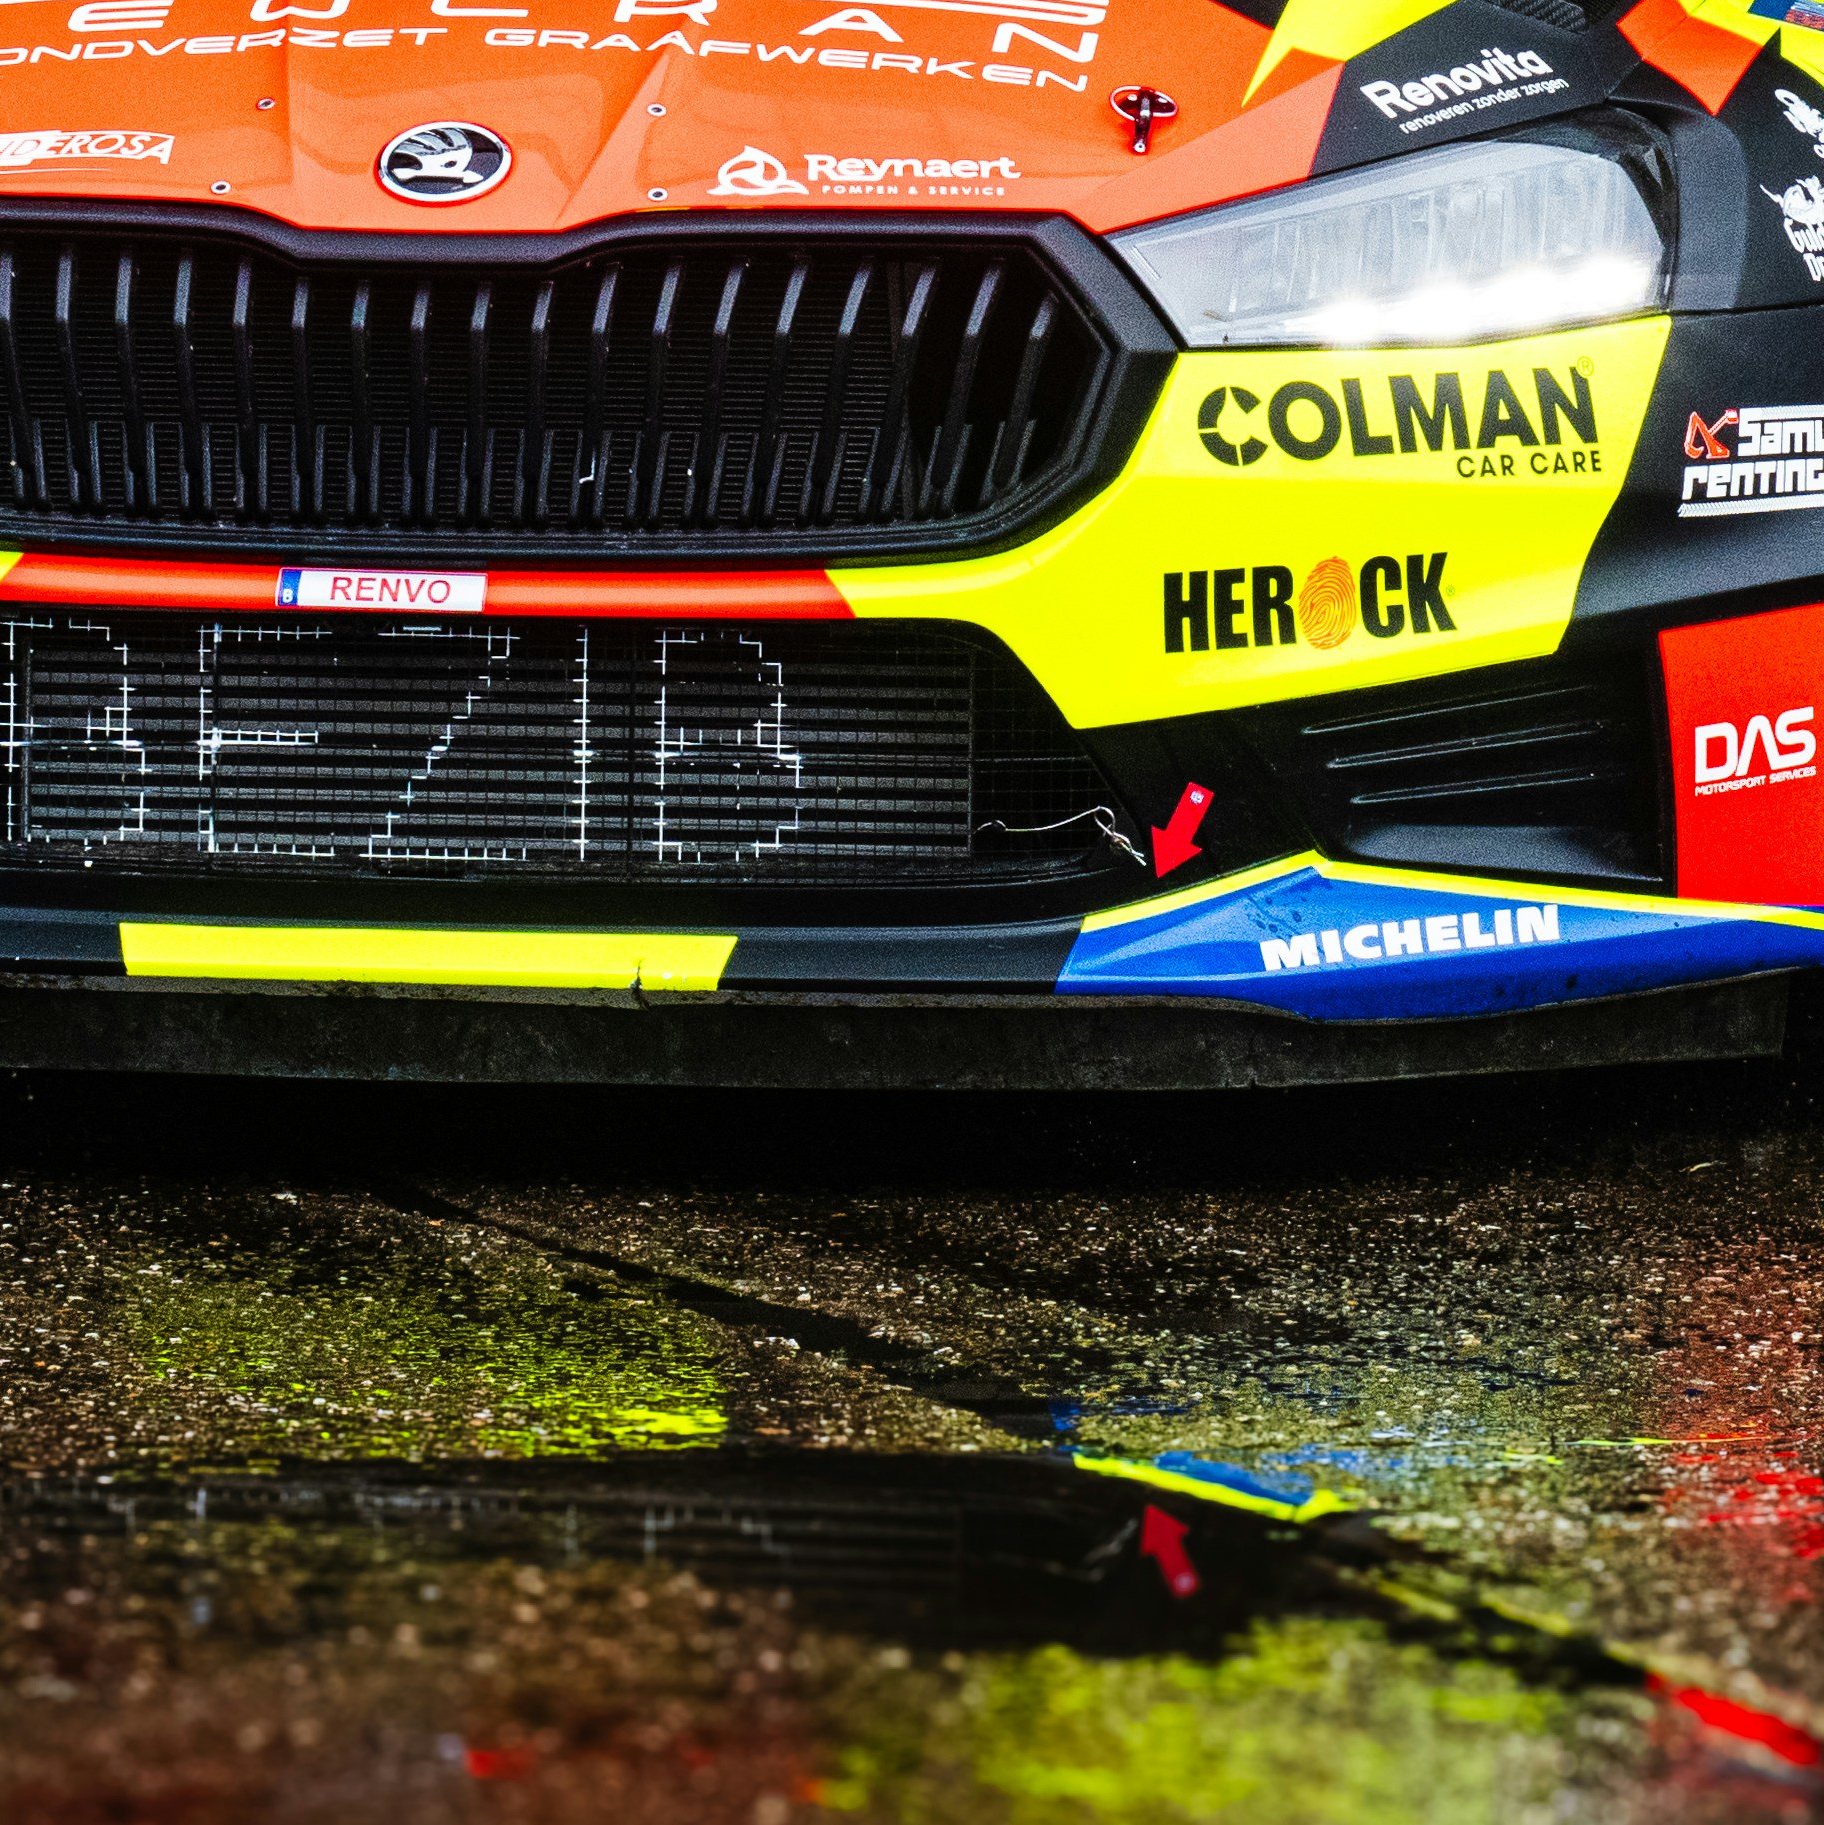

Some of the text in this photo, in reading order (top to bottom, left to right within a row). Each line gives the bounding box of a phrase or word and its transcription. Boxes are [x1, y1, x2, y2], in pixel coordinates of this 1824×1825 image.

[483, 26, 1088, 93] GRAAFWERKEN
[1359, 47, 1554, 120] Renovita
[1398, 77, 1571, 135] renoveren zonder zorgen
[803, 154, 1023, 183] Reynaert
[821, 185, 899, 195] POMPEN
[928, 186, 1006, 196] SERVICE
[1197, 365, 1601, 467] COLMAN
[1456, 449, 1603, 479] CAR CARE
[282, 576, 452, 604] B RENVO
[1694, 705, 1817, 784] DAS
[1694, 765, 1817, 797] MOTORSPORT SERVICES
[1260, 904, 1561, 972] MICHELIN
